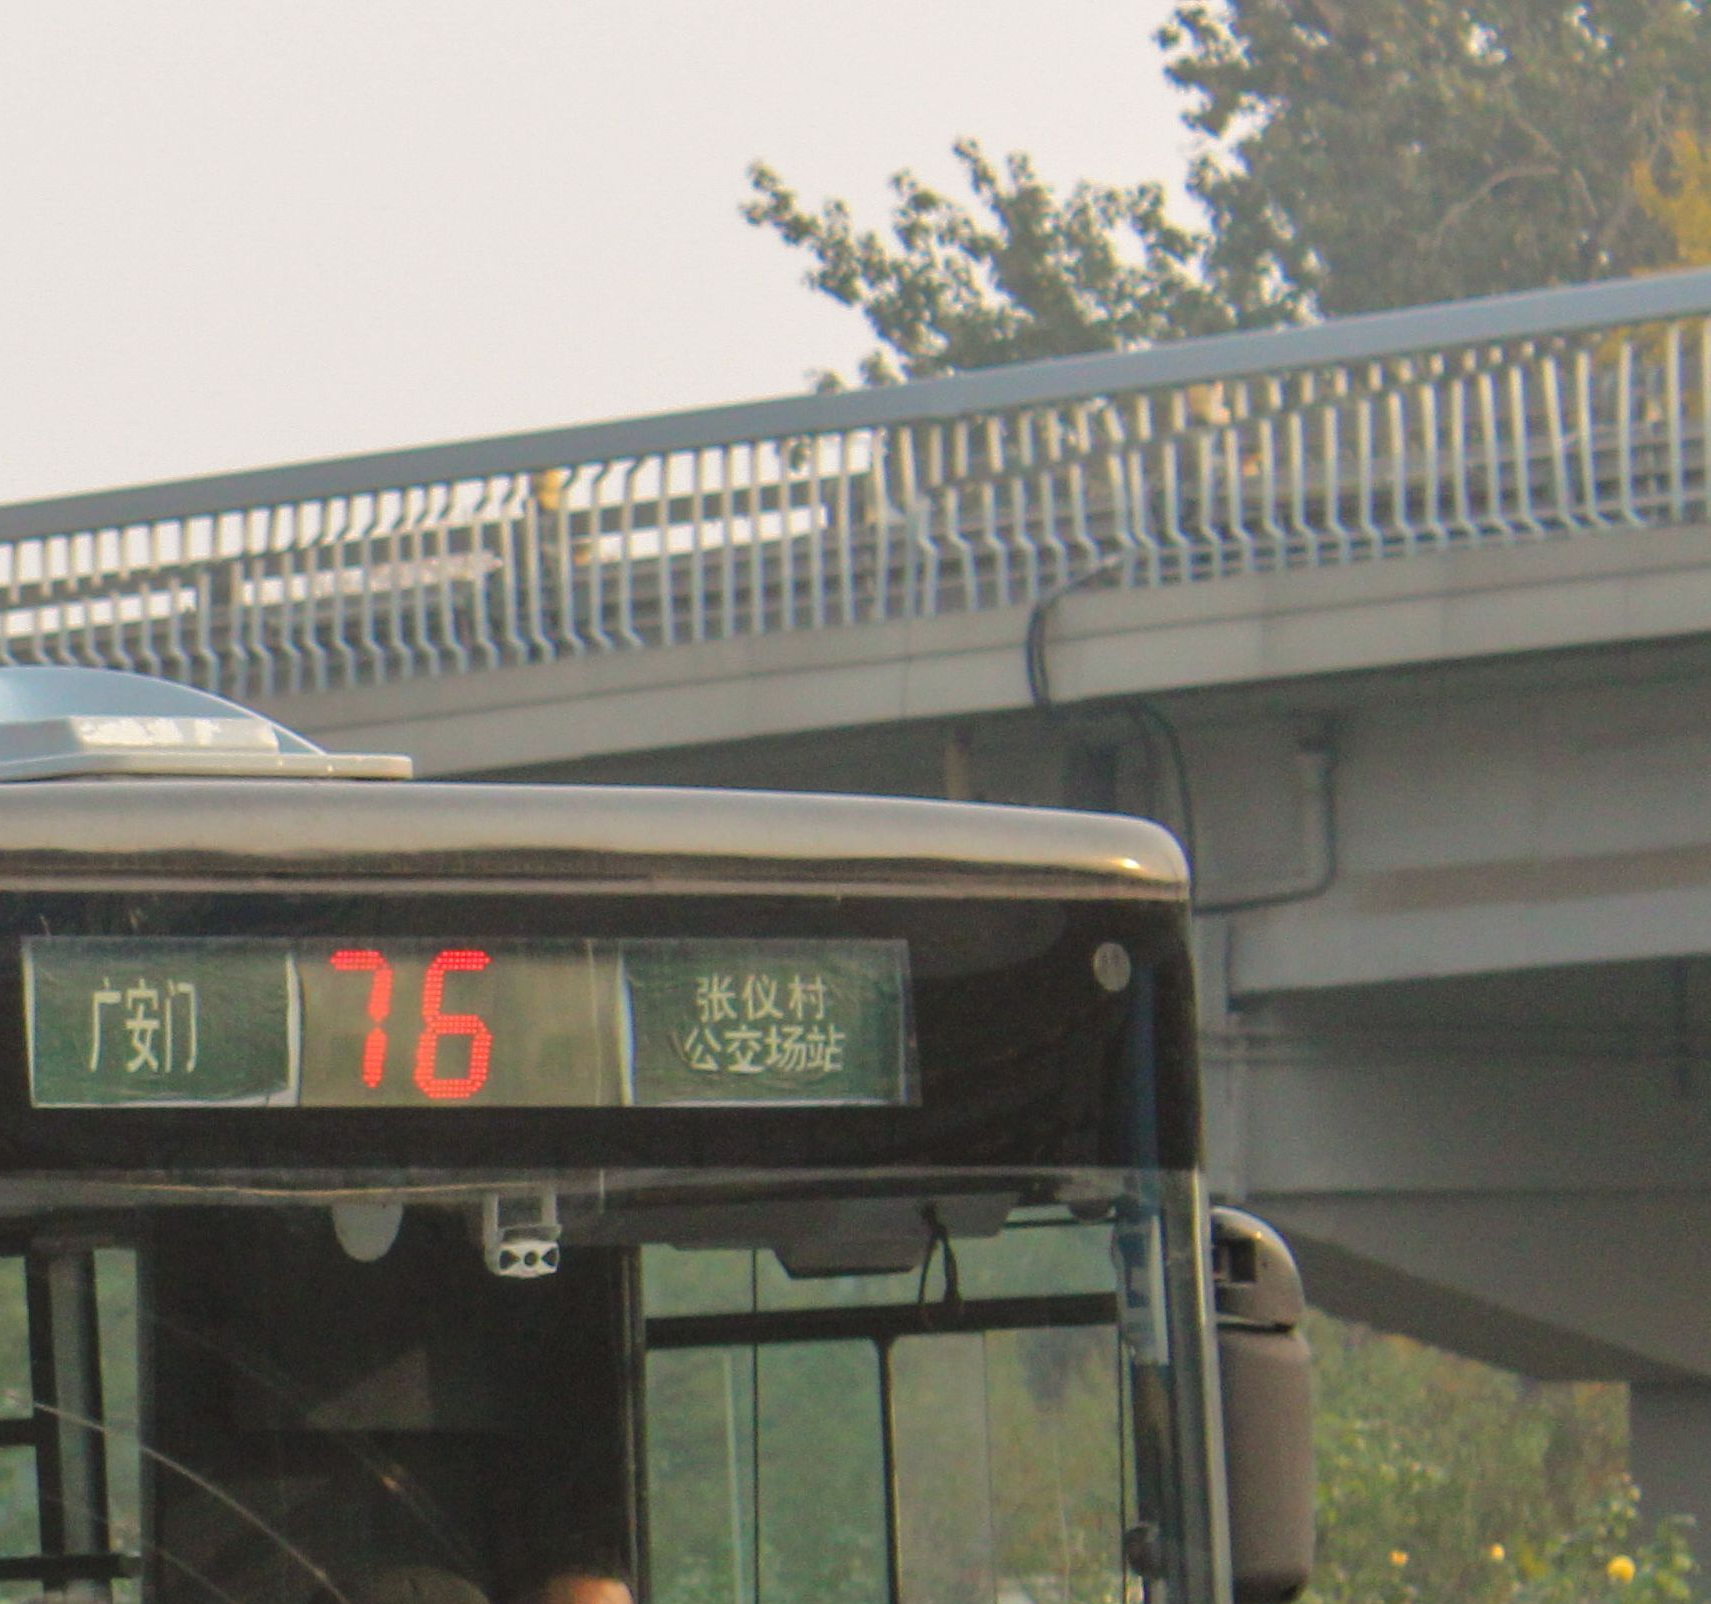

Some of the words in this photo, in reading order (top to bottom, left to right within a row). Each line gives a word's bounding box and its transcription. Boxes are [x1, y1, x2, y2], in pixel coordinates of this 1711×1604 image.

[88, 976, 197, 1073] 广安门
[330, 949, 493, 1099] 76
[695, 972, 827, 1023] 张仪村
[684, 1023, 846, 1074] 公交场站
